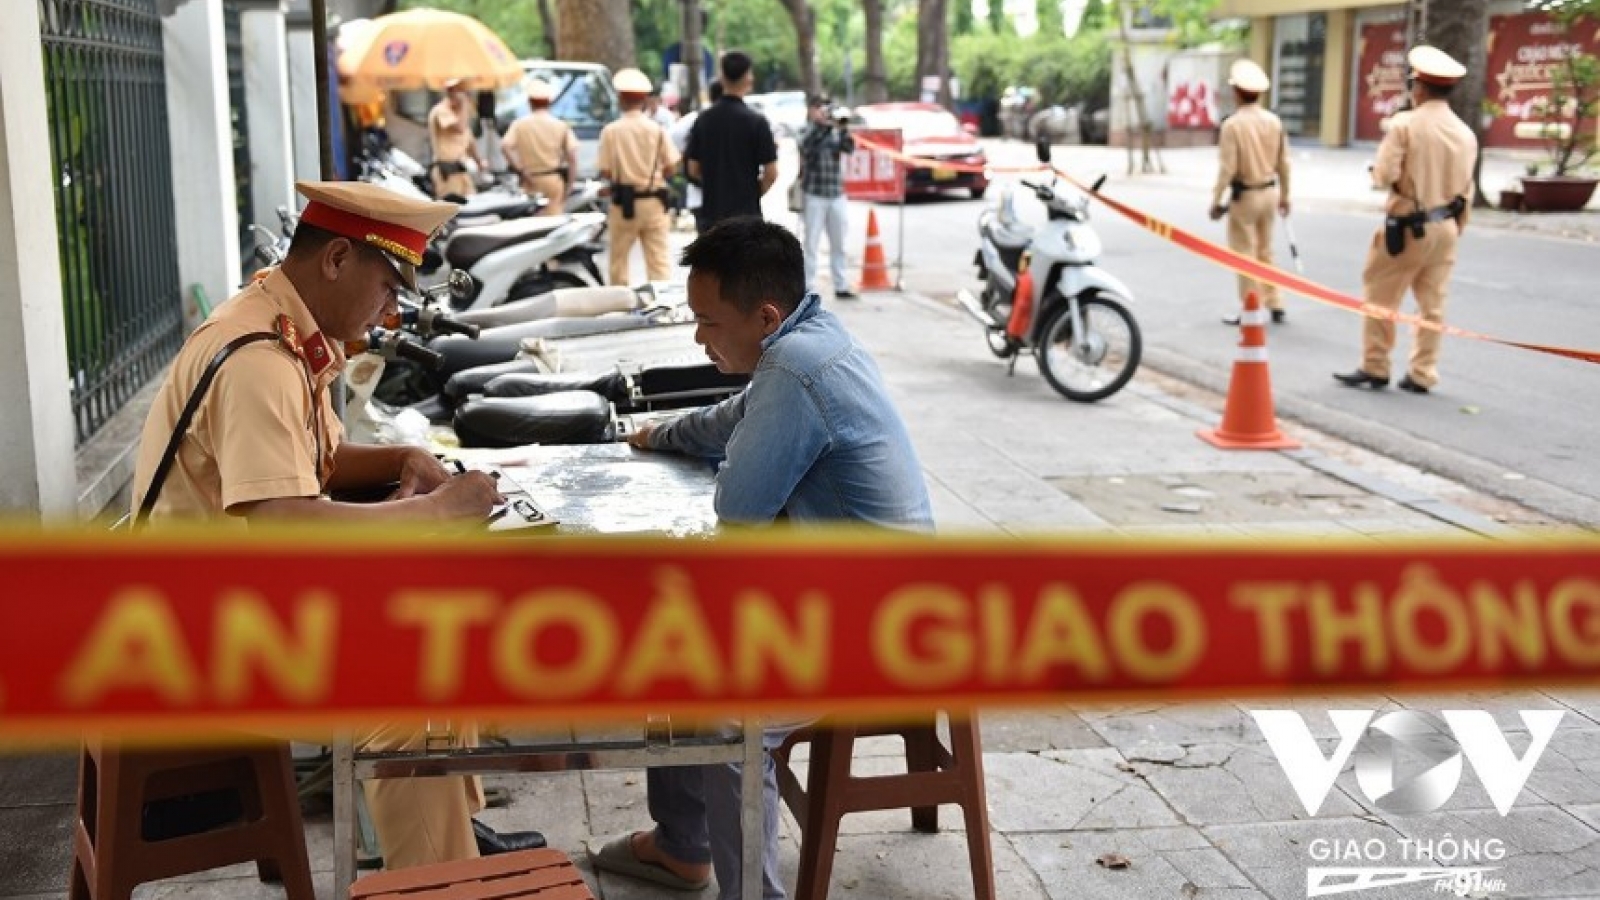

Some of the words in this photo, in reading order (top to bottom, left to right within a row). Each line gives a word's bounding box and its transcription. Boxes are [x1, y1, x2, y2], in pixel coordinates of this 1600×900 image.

[62, 587, 337, 702] AN
[388, 565, 829, 700] TOÀN
[872, 580, 1207, 687] GIAO
[1228, 562, 1600, 674] THÔNG
